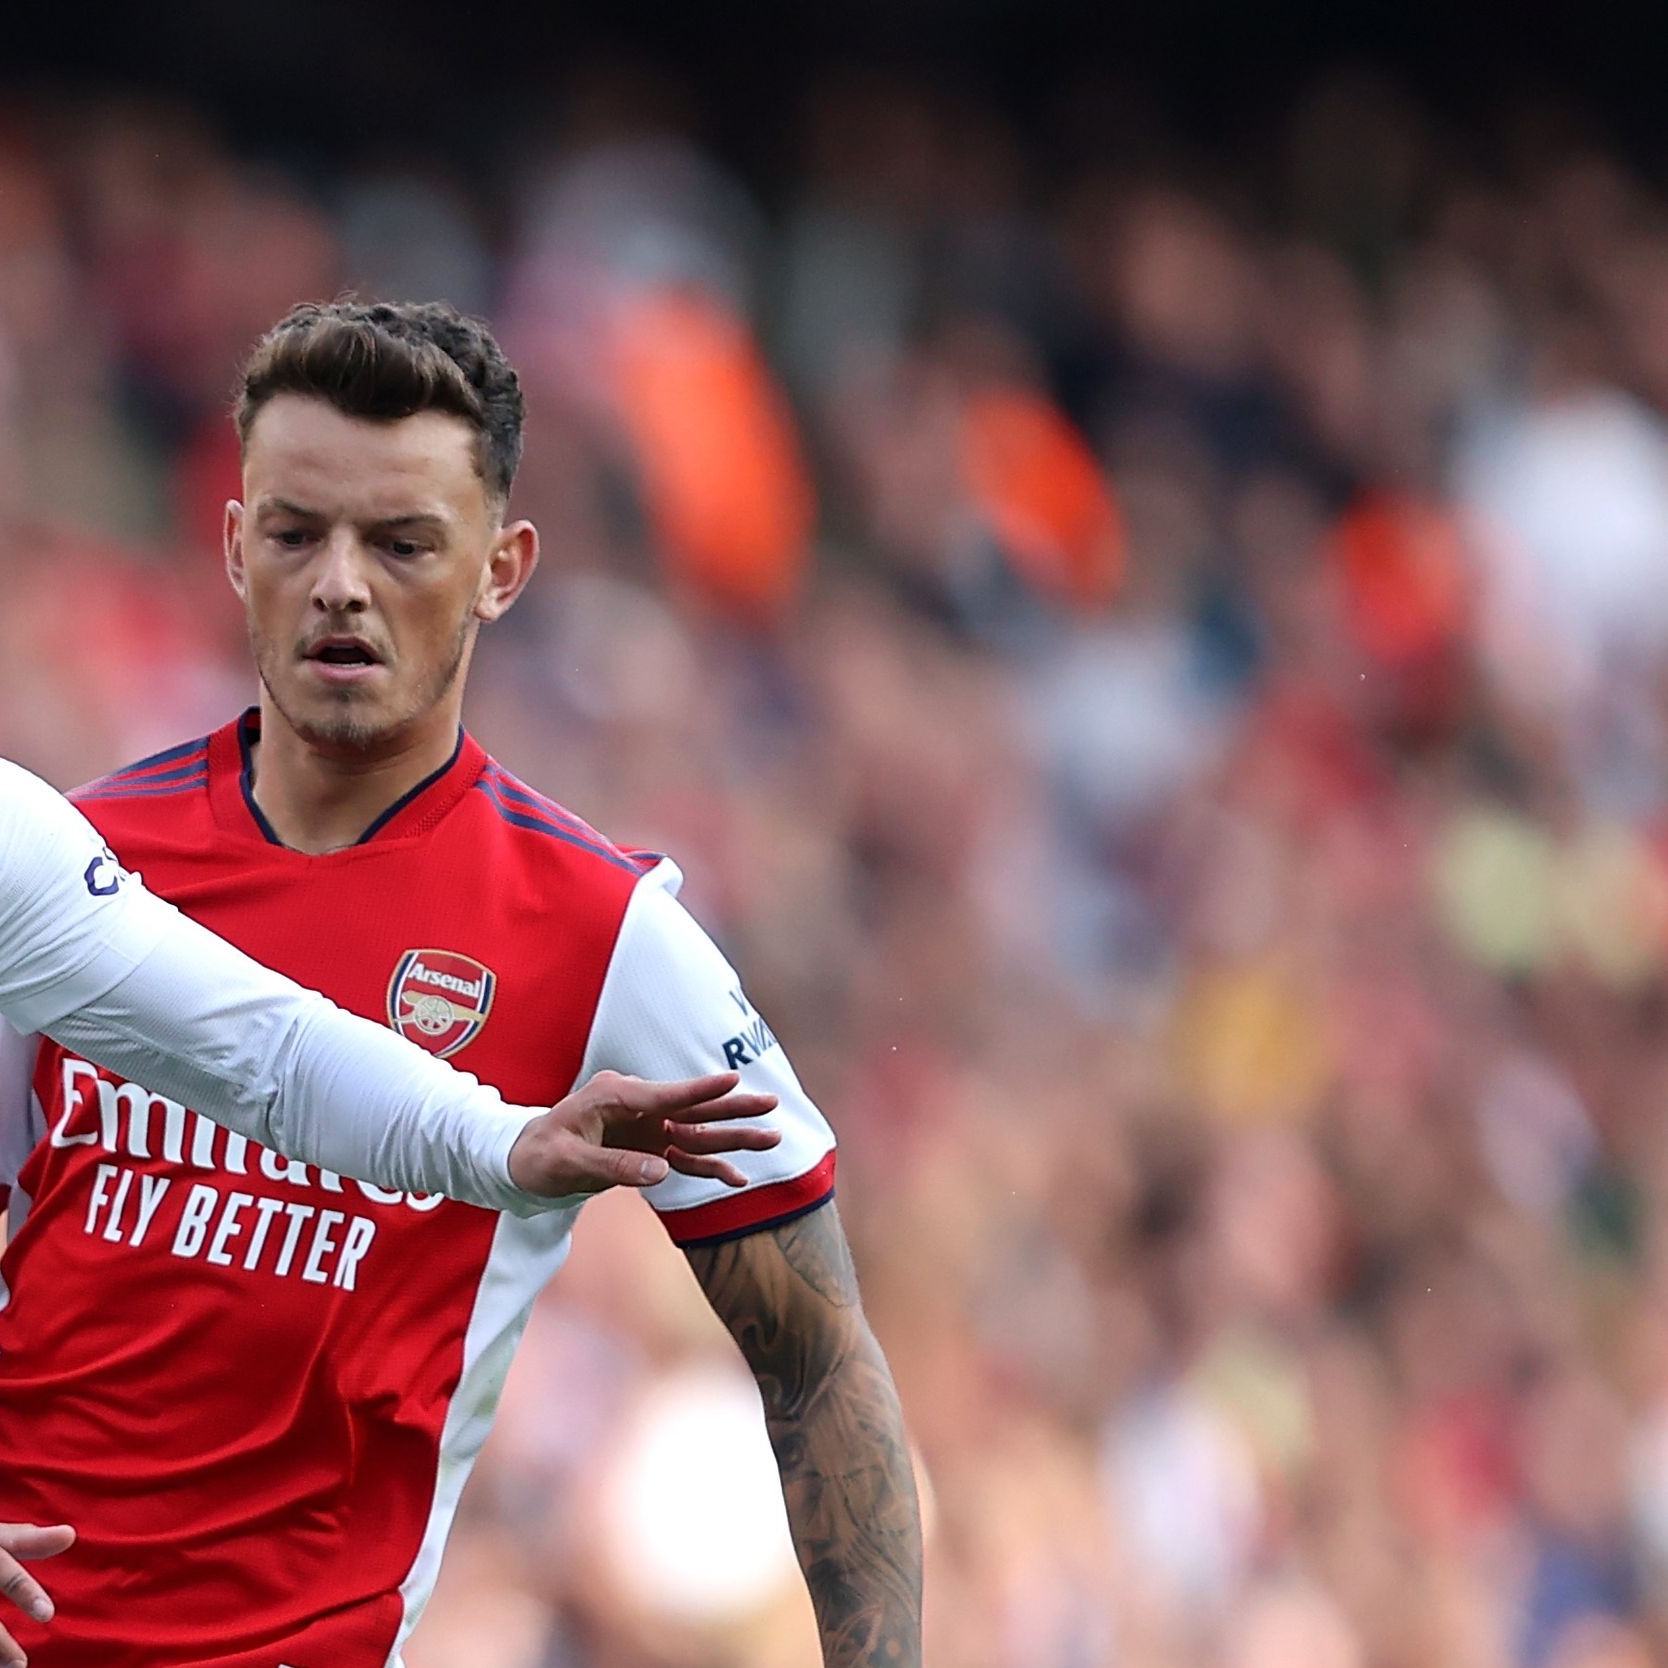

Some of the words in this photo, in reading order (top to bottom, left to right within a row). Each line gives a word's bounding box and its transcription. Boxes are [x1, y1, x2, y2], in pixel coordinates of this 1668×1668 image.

[407, 963, 481, 999] Arsenal
[84, 1163, 171, 1248] FLY
[171, 1184, 377, 1291] BETTER
